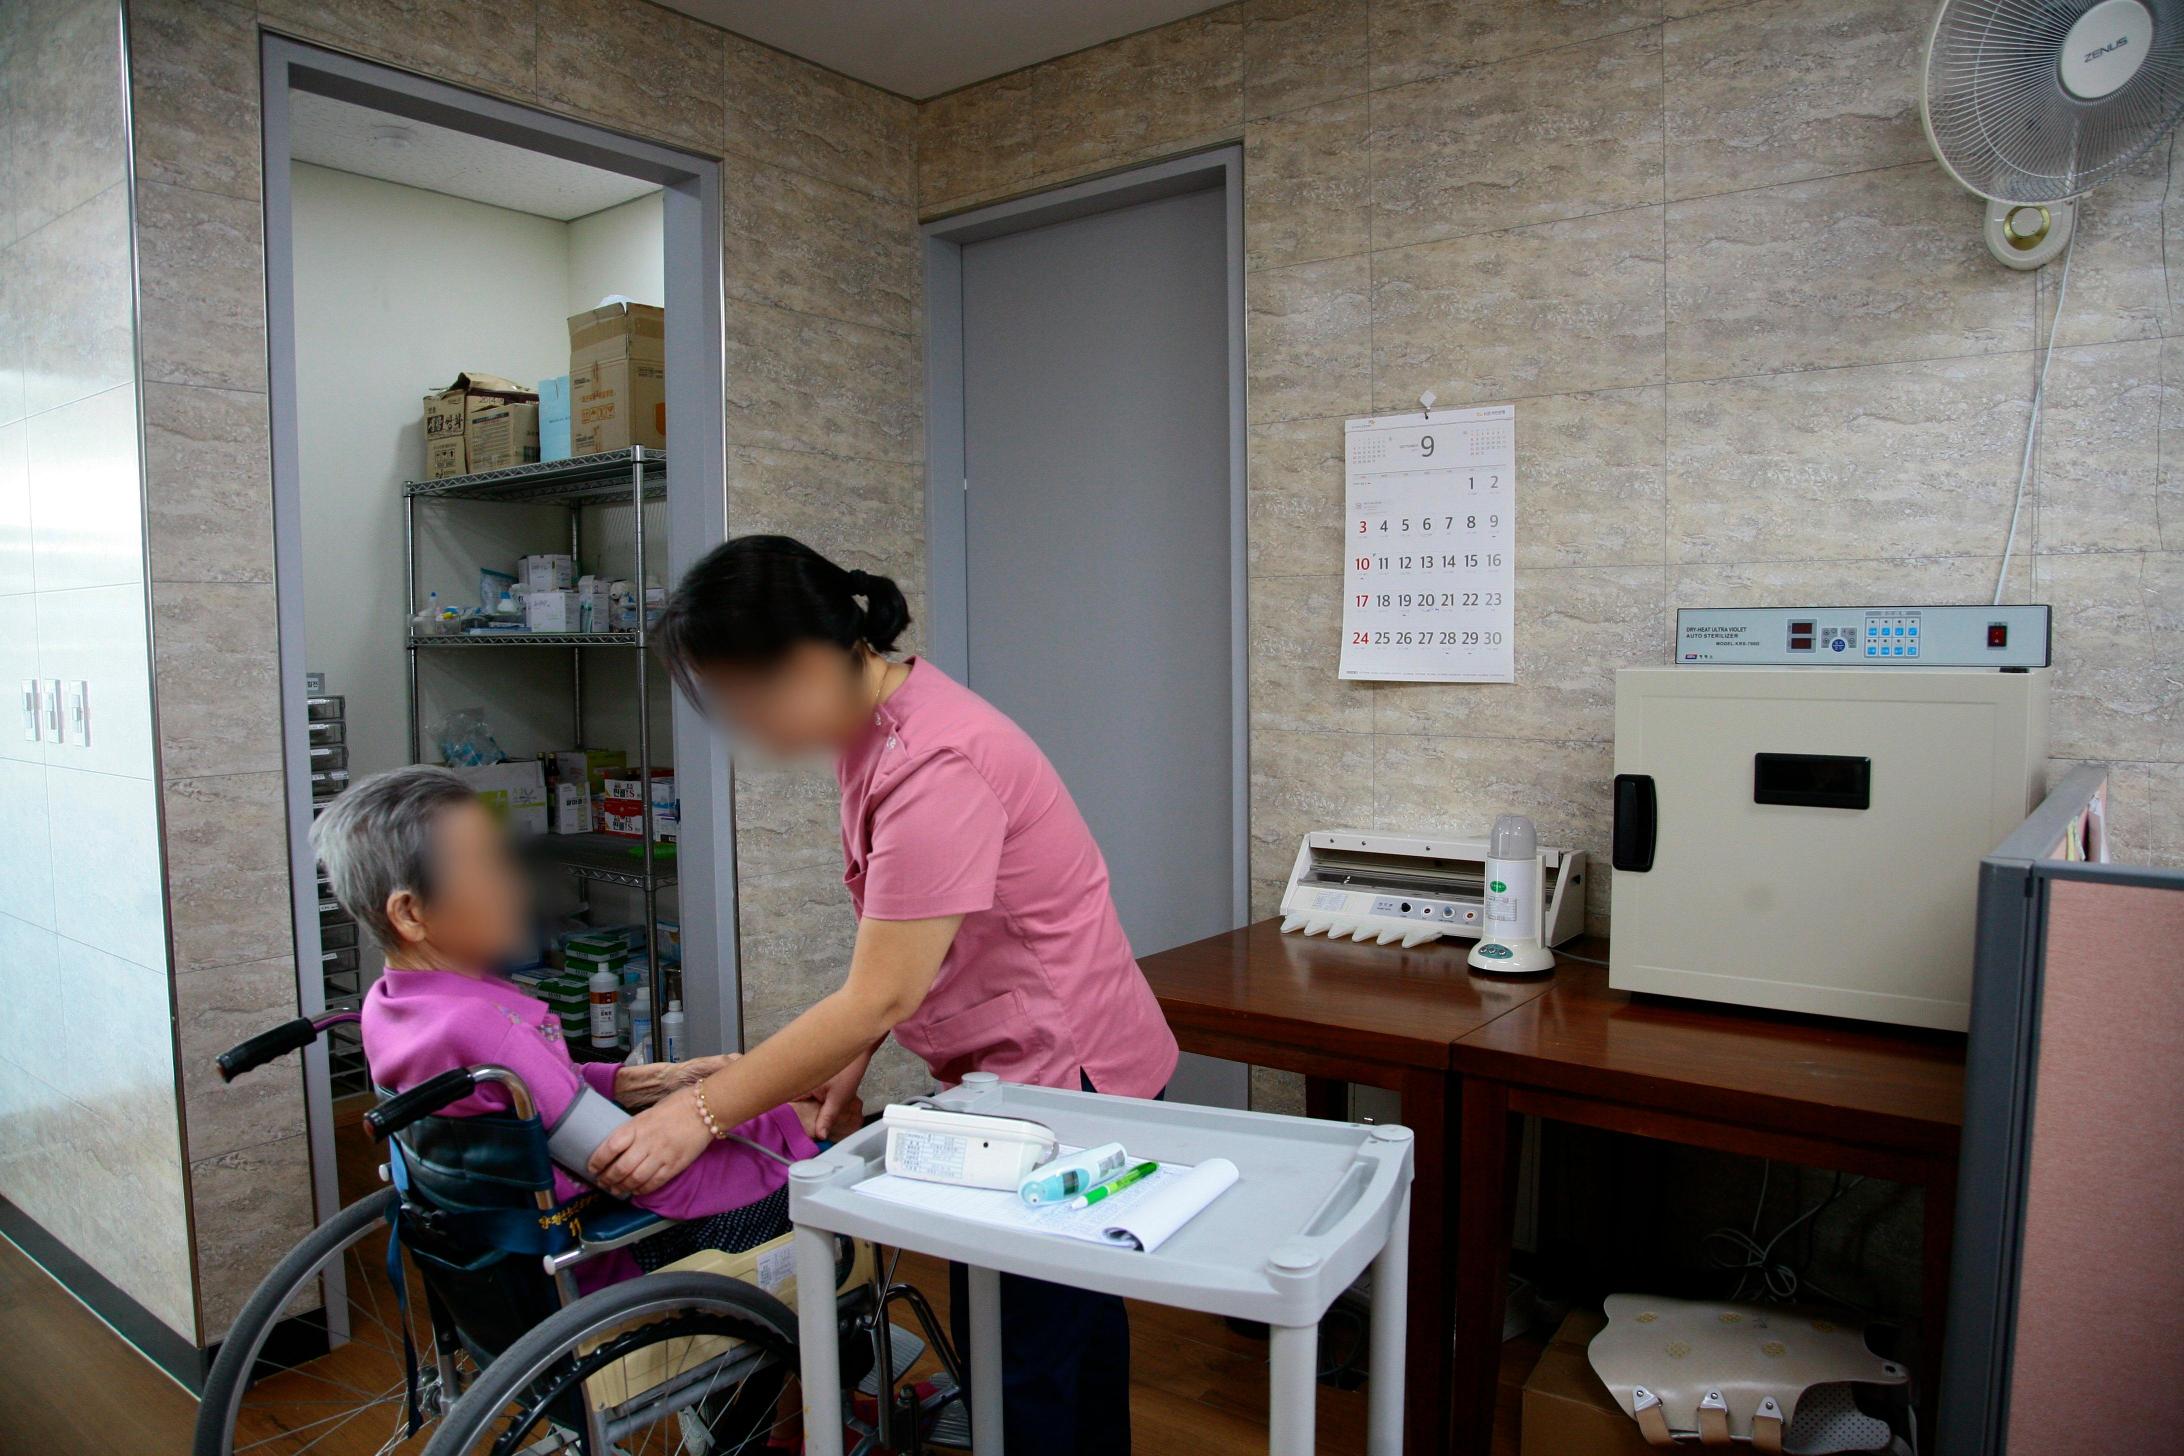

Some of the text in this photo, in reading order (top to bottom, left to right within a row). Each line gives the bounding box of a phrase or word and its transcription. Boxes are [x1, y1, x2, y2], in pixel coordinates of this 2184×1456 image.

[2084, 36, 2128, 63] ZENUS
[1420, 435, 1435, 457] 9
[1468, 476, 1499, 490] 1 2
[1359, 515, 1499, 534] 3 4 5 6 7 8 9
[1355, 553, 1502, 571] 10 11 12 13 14 15 16
[1355, 593, 1502, 608] 17 18 19 20 21 22 23
[1352, 632, 1502, 645] 24 25 26 27 28 29 30
